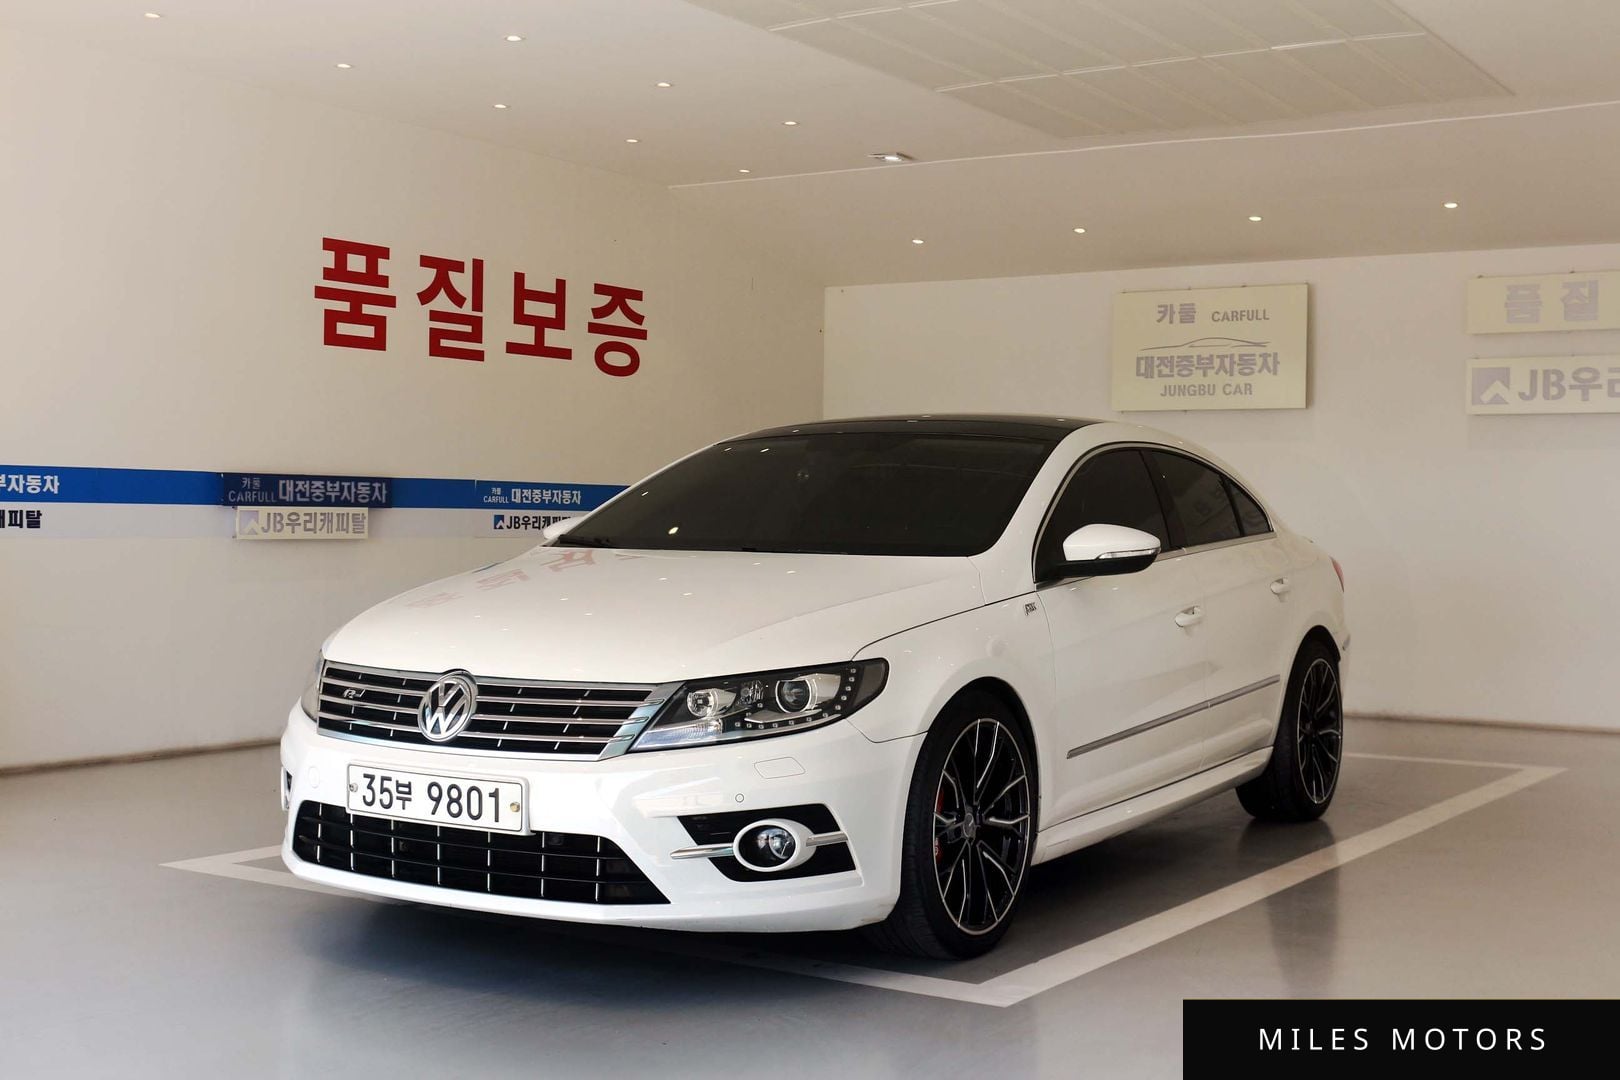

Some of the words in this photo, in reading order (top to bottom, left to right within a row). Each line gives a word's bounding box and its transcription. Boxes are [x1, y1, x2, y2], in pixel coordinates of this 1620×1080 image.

[314, 237, 648, 377] 품질보증
[1211, 309, 1270, 322] CARFULL
[1136, 352, 1280, 379] 대전중부자동차
[1160, 384, 1216, 397] JUNGBU
[1222, 383, 1253, 396] CAR
[228, 490, 277, 502] CARFULL
[279, 479, 388, 504] 대전중부자동차
[483, 495, 509, 504] CARFULL
[511, 488, 582, 505] 대전중부자동차
[261, 511, 367, 535] JB우리캐피탈
[506, 515, 571, 530] JB우리캐
[362, 773, 412, 810] 35부
[427, 781, 500, 823] 9801
